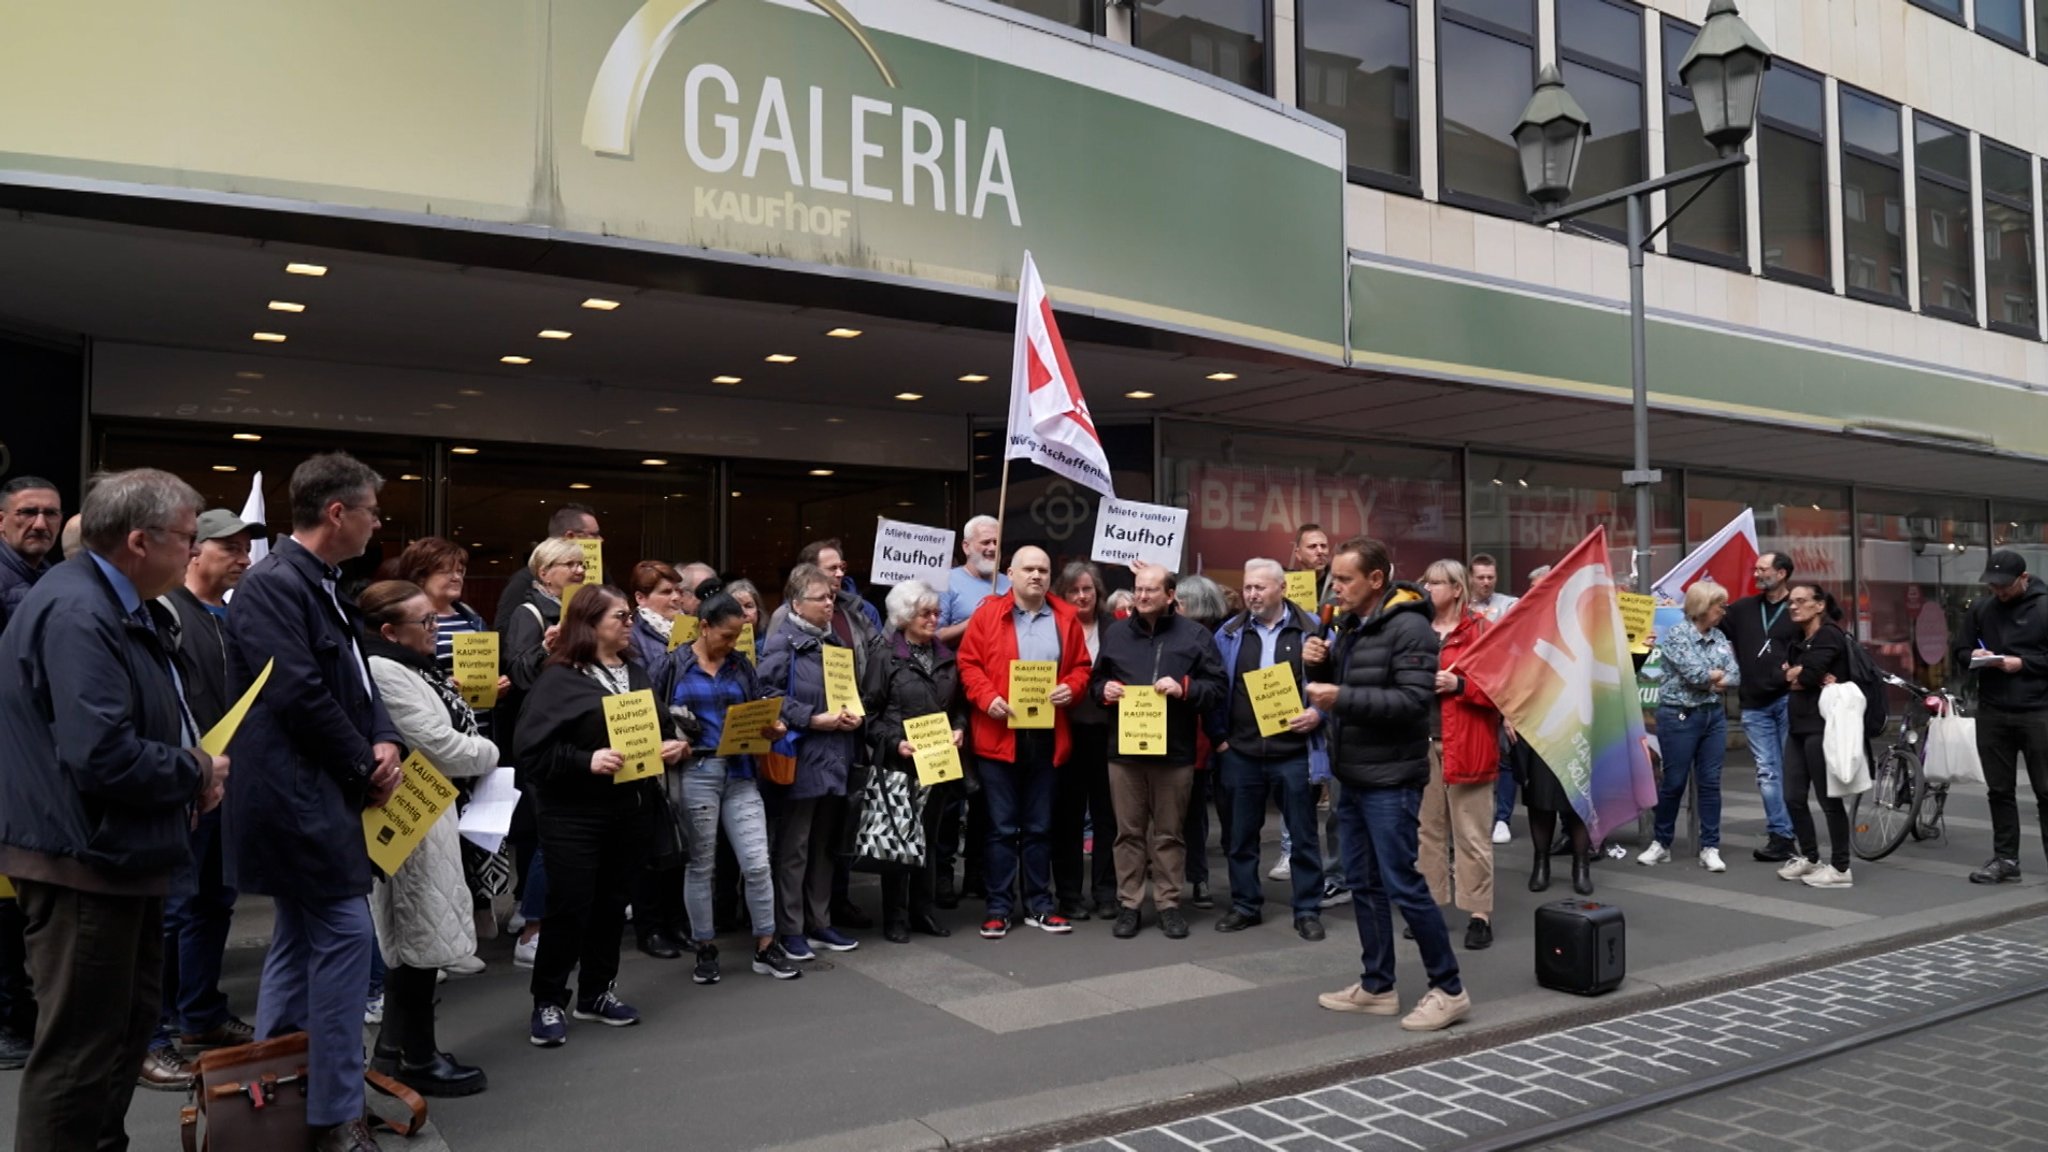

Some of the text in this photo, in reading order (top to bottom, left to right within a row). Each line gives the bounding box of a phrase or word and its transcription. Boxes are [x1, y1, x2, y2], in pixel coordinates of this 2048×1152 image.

[684, 63, 1022, 226] GALERIA
[1108, 505, 1176, 524] Miete runter!
[1201, 479, 1377, 536] BEAUTY
[885, 528, 946, 544] Miete runter!
[1104, 524, 1175, 547] Kaufhof
[882, 545, 944, 568] Kaufhof
[1101, 549, 1139, 560] retten!
[1255, 685, 1293, 701] KAUFHOF
[1263, 681, 1281, 690] Zum
[625, 737, 648, 747] muss
[410, 760, 452, 799] KAUFHOF
[394, 794, 421, 823] richtig
